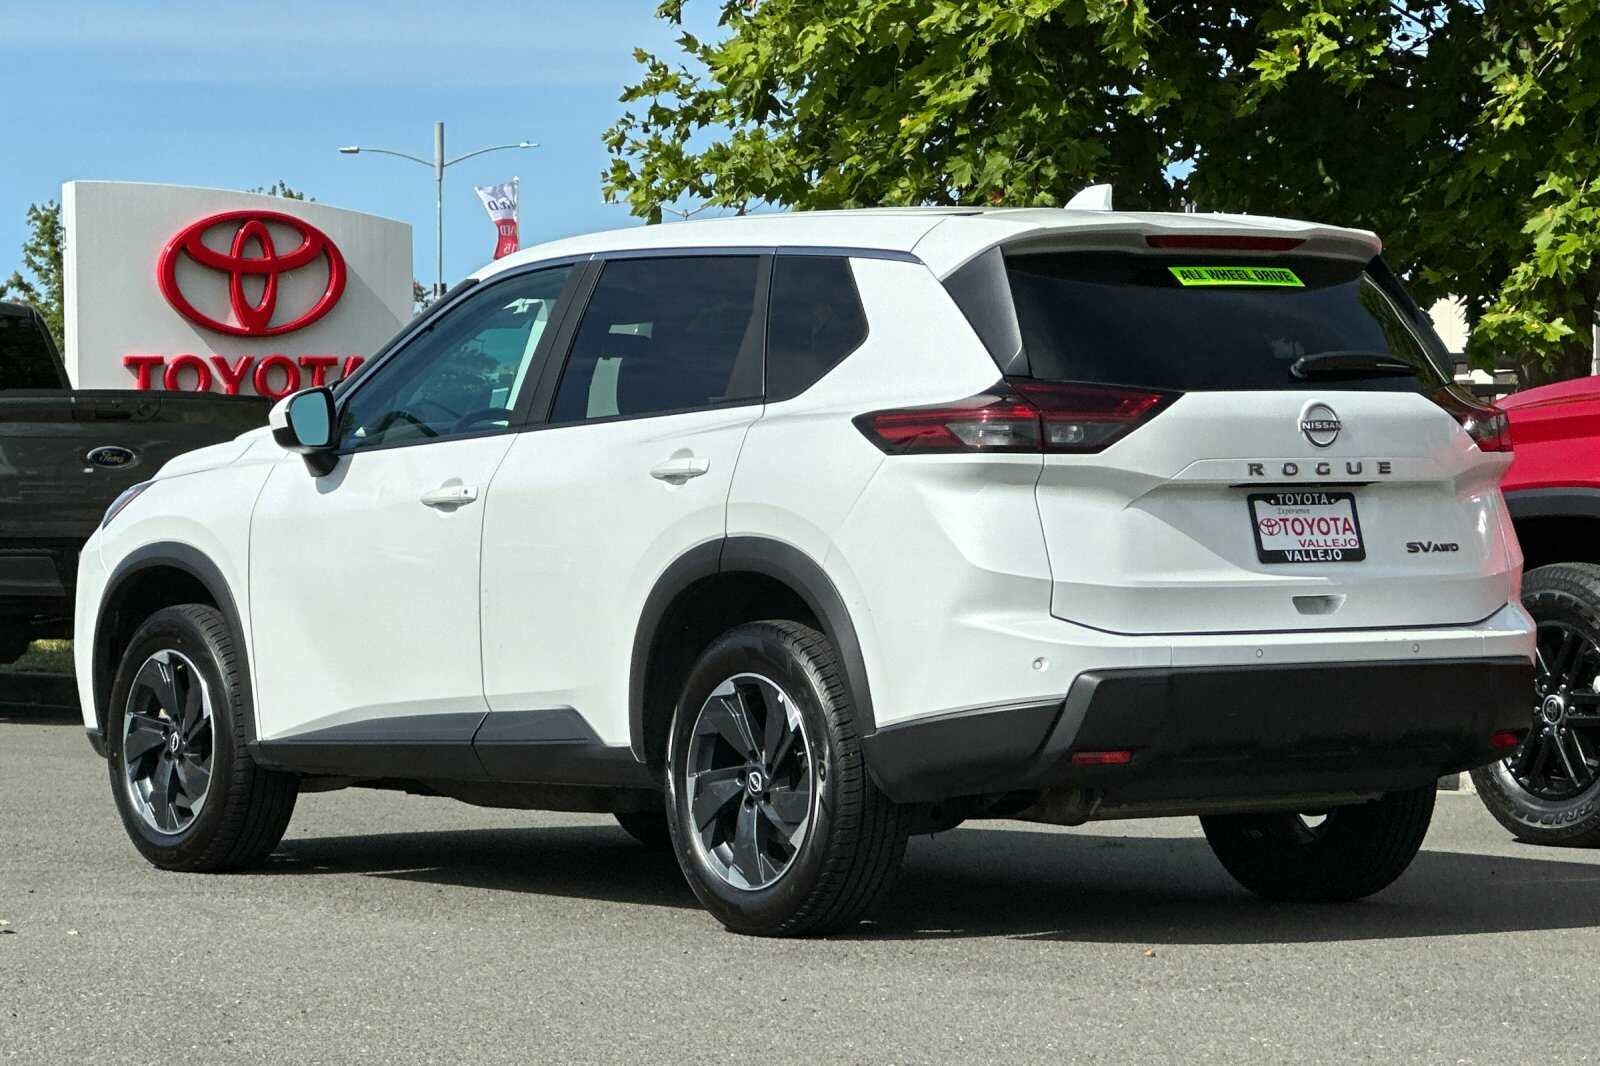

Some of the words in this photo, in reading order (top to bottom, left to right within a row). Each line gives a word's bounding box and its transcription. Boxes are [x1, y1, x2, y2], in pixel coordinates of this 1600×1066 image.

[1179, 269, 1206, 280] ALL
[1208, 270, 1252, 281] WHEEL
[1254, 271, 1294, 282] DRIVE
[123, 354, 365, 400] TOYOT
[1302, 421, 1343, 430] NISSAN
[1248, 461, 1392, 476] ROGUE
[1277, 493, 1329, 505] TOYOTA
[1279, 517, 1356, 536] TOYOTA
[1298, 538, 1358, 548] VALLEJO
[1285, 549, 1342, 561] VALLEJO
